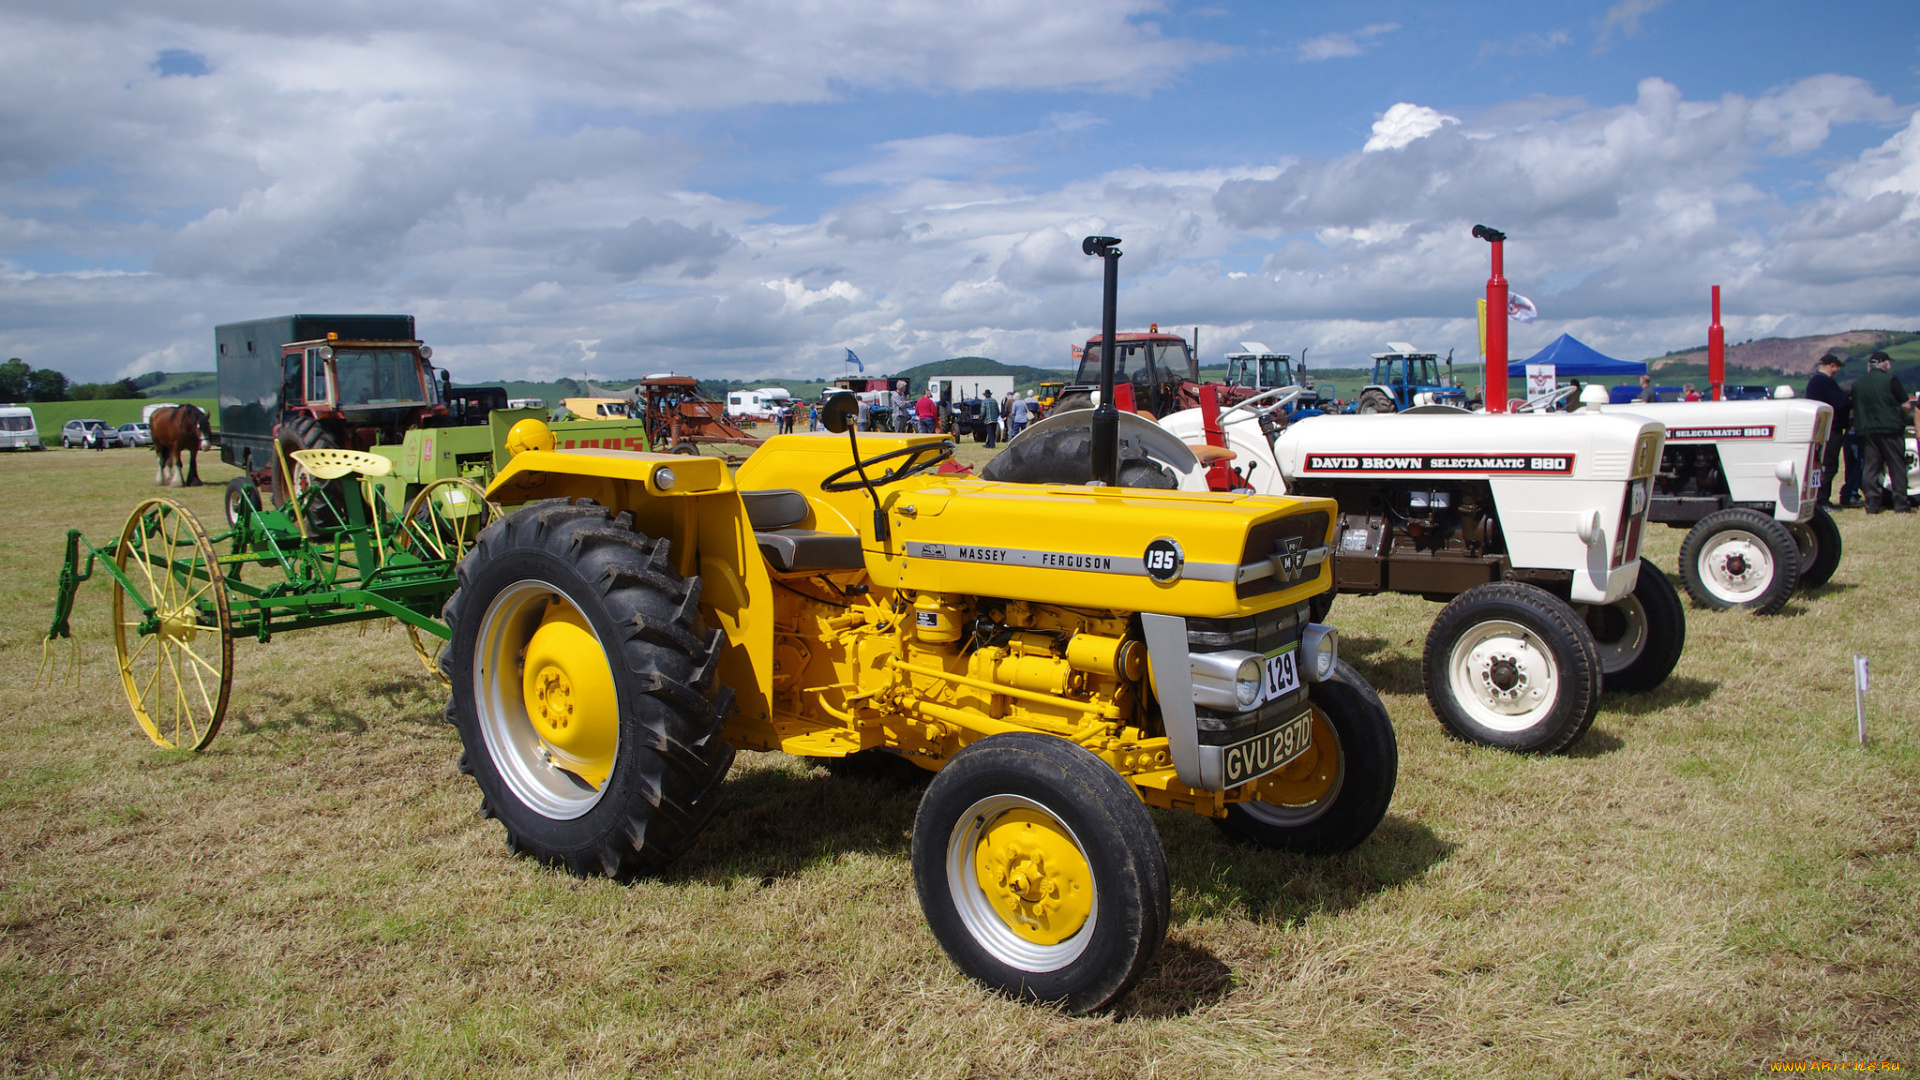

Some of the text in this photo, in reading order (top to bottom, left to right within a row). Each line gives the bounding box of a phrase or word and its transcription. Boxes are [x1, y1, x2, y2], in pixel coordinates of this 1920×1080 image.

[1675, 429, 1742, 438] SELECTAMATIC
[1311, 457, 1566, 470] DAVID BROWN SELECTAMATIC 880
[959, 548, 1007, 562] MASSEY
[1042, 553, 1111, 570] FERGUSON
[1147, 549, 1175, 570] 135
[1267, 653, 1294, 694] 129
[1227, 716, 1310, 780] GVU 297D
